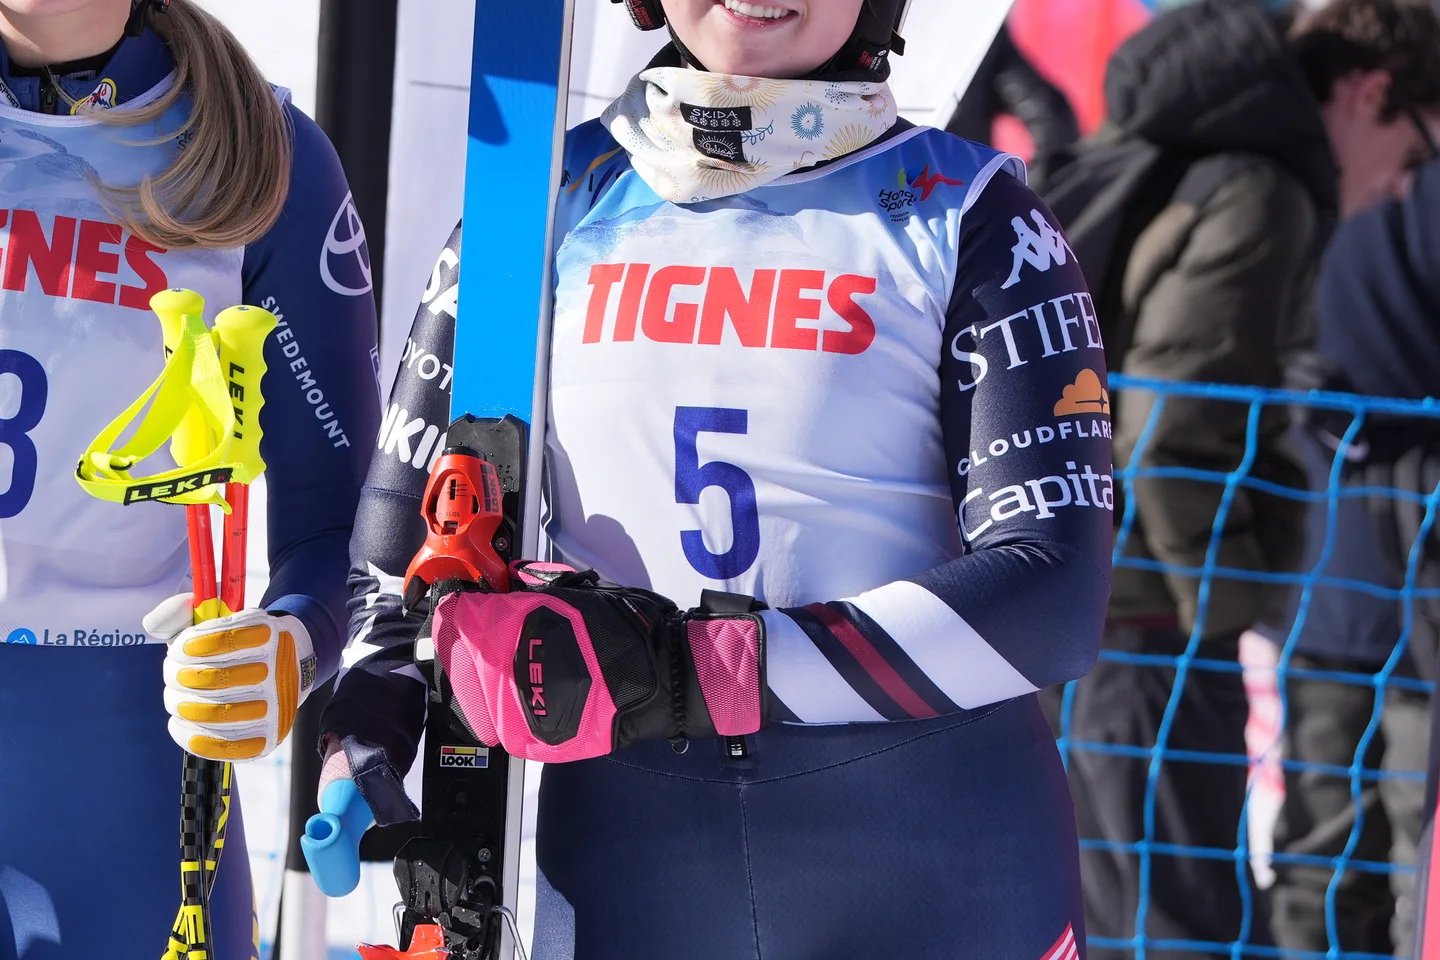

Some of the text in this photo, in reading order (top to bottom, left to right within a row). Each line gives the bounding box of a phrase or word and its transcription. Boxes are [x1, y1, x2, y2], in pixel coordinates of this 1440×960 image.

[691, 108, 738, 119] SKIDA
[582, 263, 876, 355] TIGNES
[229, 361, 245, 440] LEKI
[261, 296, 350, 450] SWEDEMOUNT
[127, 473, 212, 502] LEKI
[674, 406, 760, 580] 5
[958, 461, 1113, 542] Capita
[43, 629, 146, 646] La Région
[528, 638, 548, 717] LEKI
[441, 755, 475, 767] LOOK
